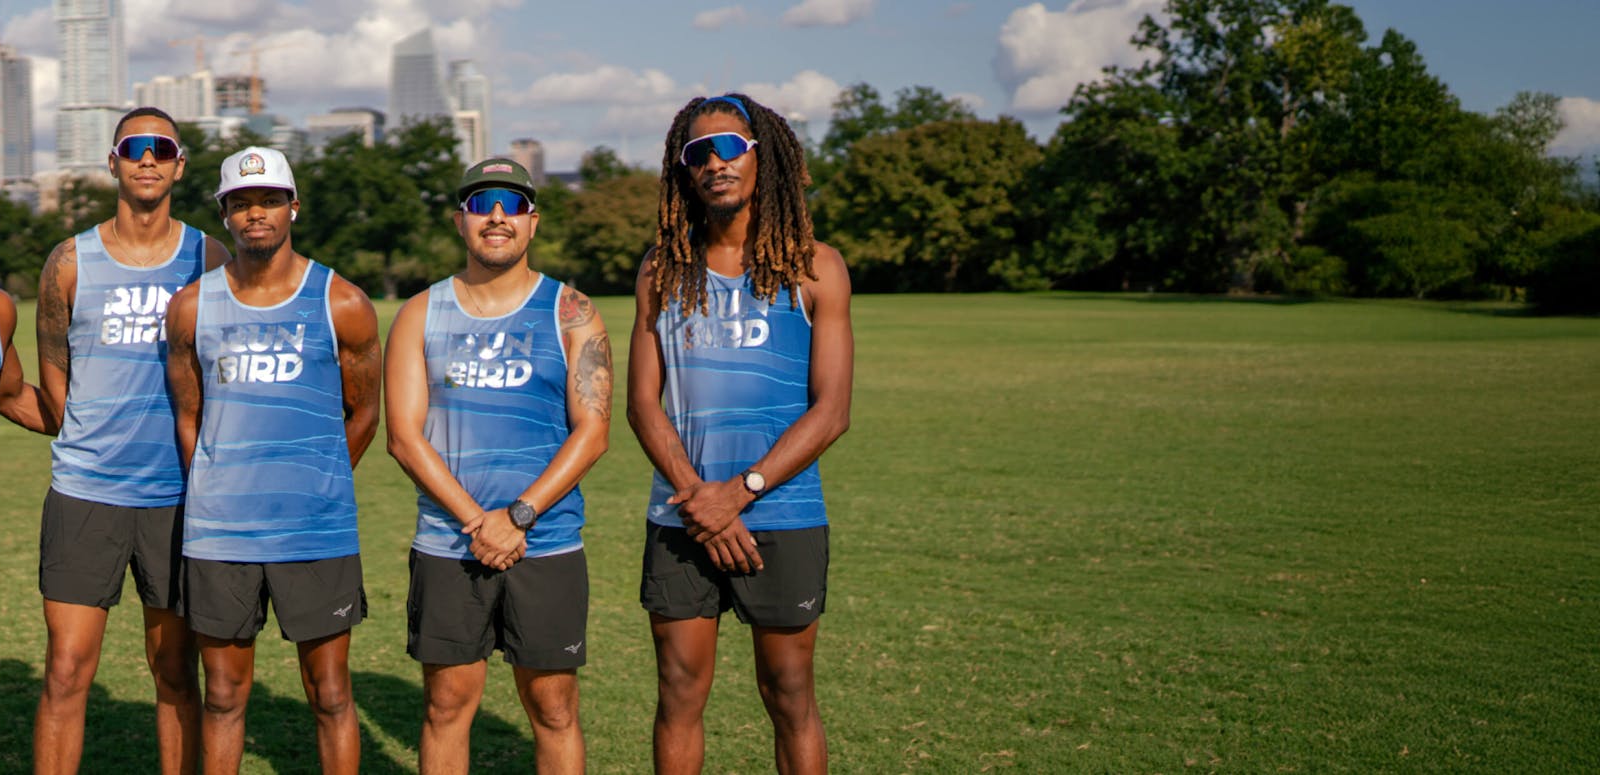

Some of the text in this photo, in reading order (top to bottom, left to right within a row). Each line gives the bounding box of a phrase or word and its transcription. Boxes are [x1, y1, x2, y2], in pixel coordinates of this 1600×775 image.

[101, 314, 167, 345] BIR
[217, 353, 304, 384] BIRD
[444, 359, 533, 389] BIRD
